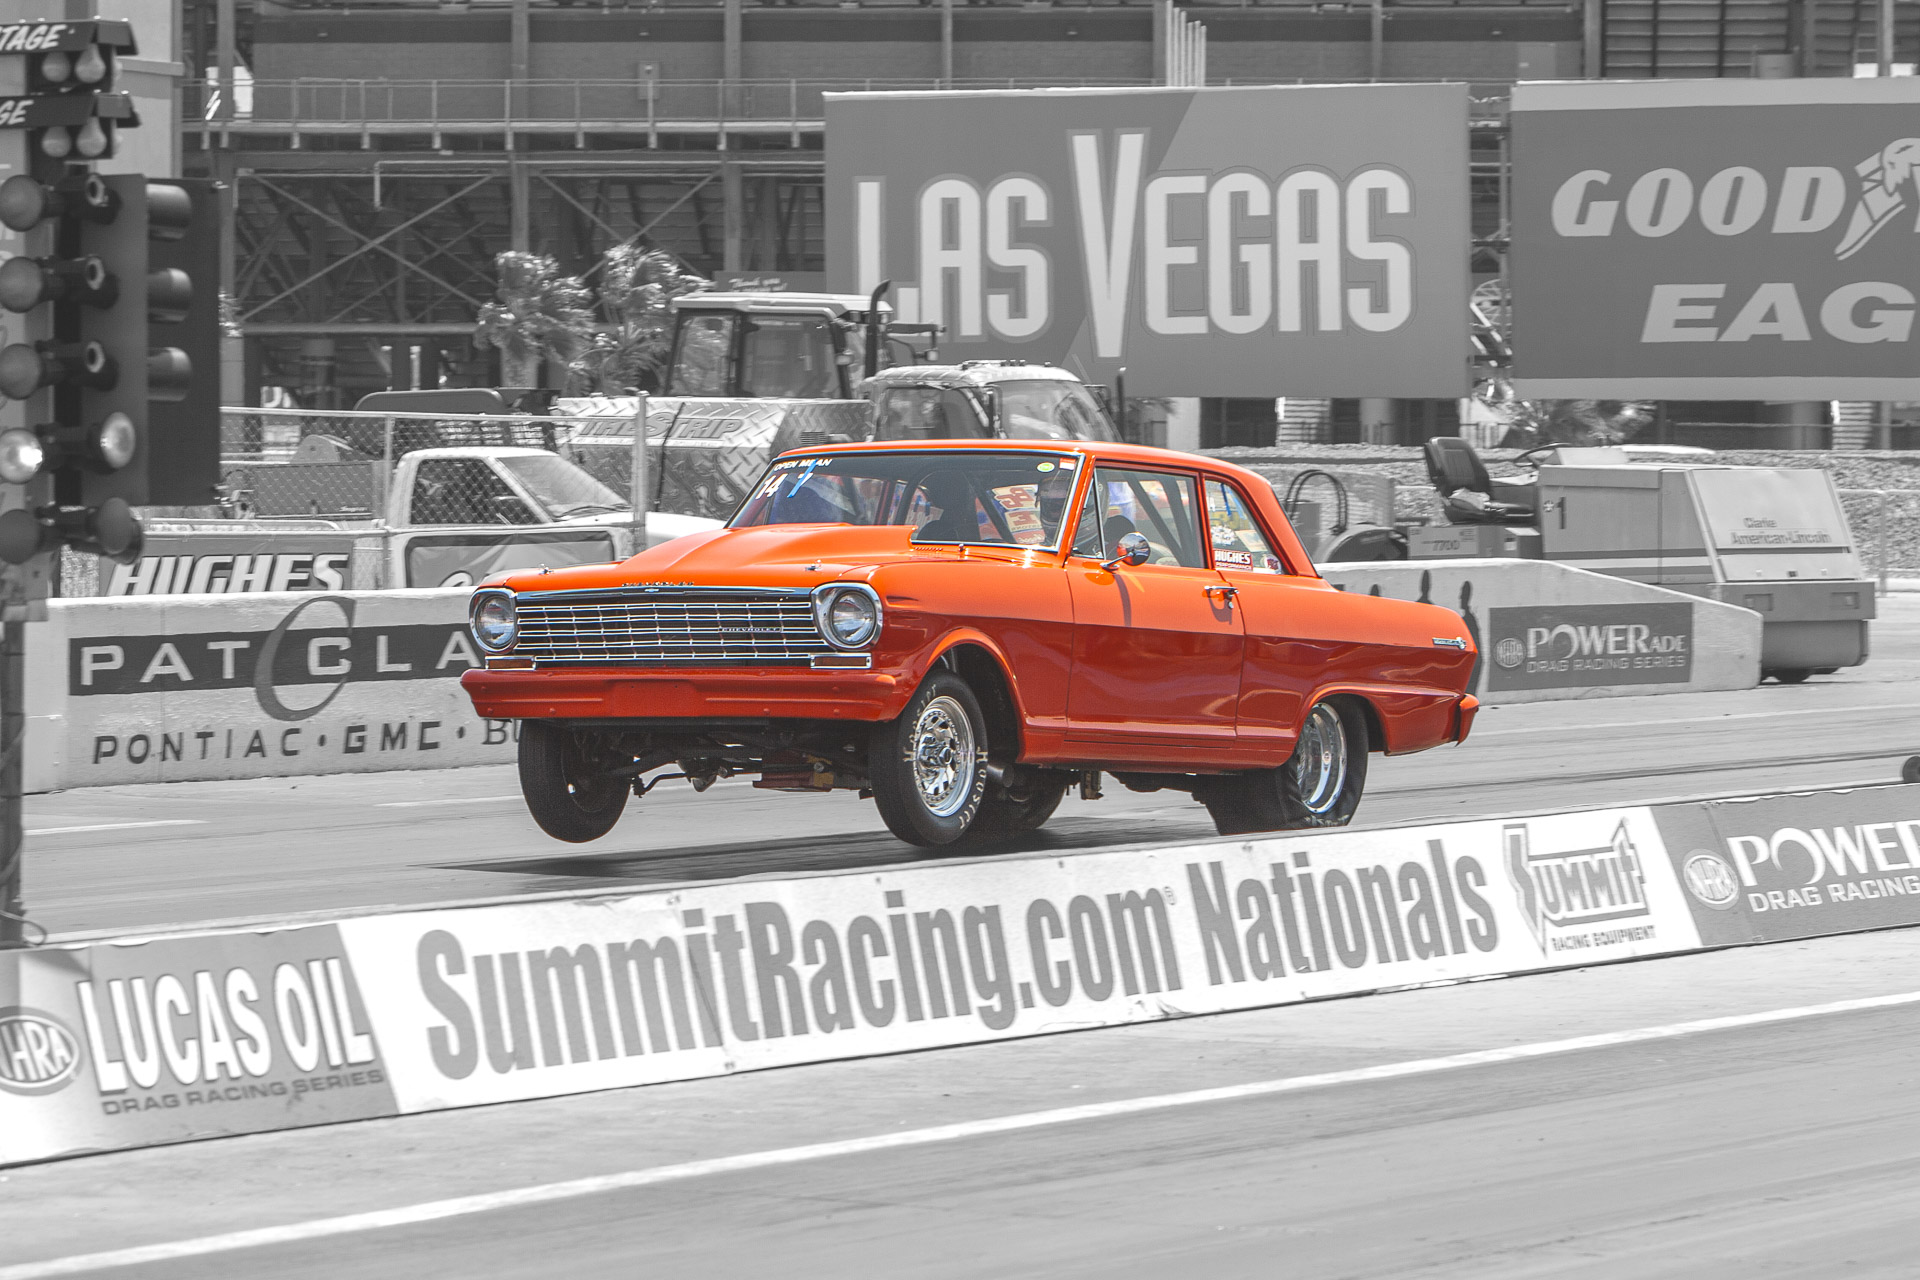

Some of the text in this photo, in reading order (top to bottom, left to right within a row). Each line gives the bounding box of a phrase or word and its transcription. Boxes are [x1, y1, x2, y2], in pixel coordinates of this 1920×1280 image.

[0, 24, 67, 50] TAGE
[1552, 165, 1920, 237] GOOD
[857, 133, 1411, 358] LAS VEGAS
[1640, 281, 1917, 343] EAG
[106, 554, 349, 596] HUGHES
[1214, 550, 1251, 565] HUGHES
[80, 631, 481, 686] PAT CLA
[1526, 656, 1686, 673] DRAG RACING SERIES
[93, 728, 302, 765] PONTIAC
[342, 720, 442, 755] GMC
[1748, 874, 1920, 913] DRAG RACING
[416, 839, 1498, 1080] SummitRacing.com Nationals
[1551, 925, 1656, 951] RACING EQUIPMENT
[76, 957, 376, 1095] LUCAS OIL
[102, 1069, 384, 1117] DRAG RACING SERIES
